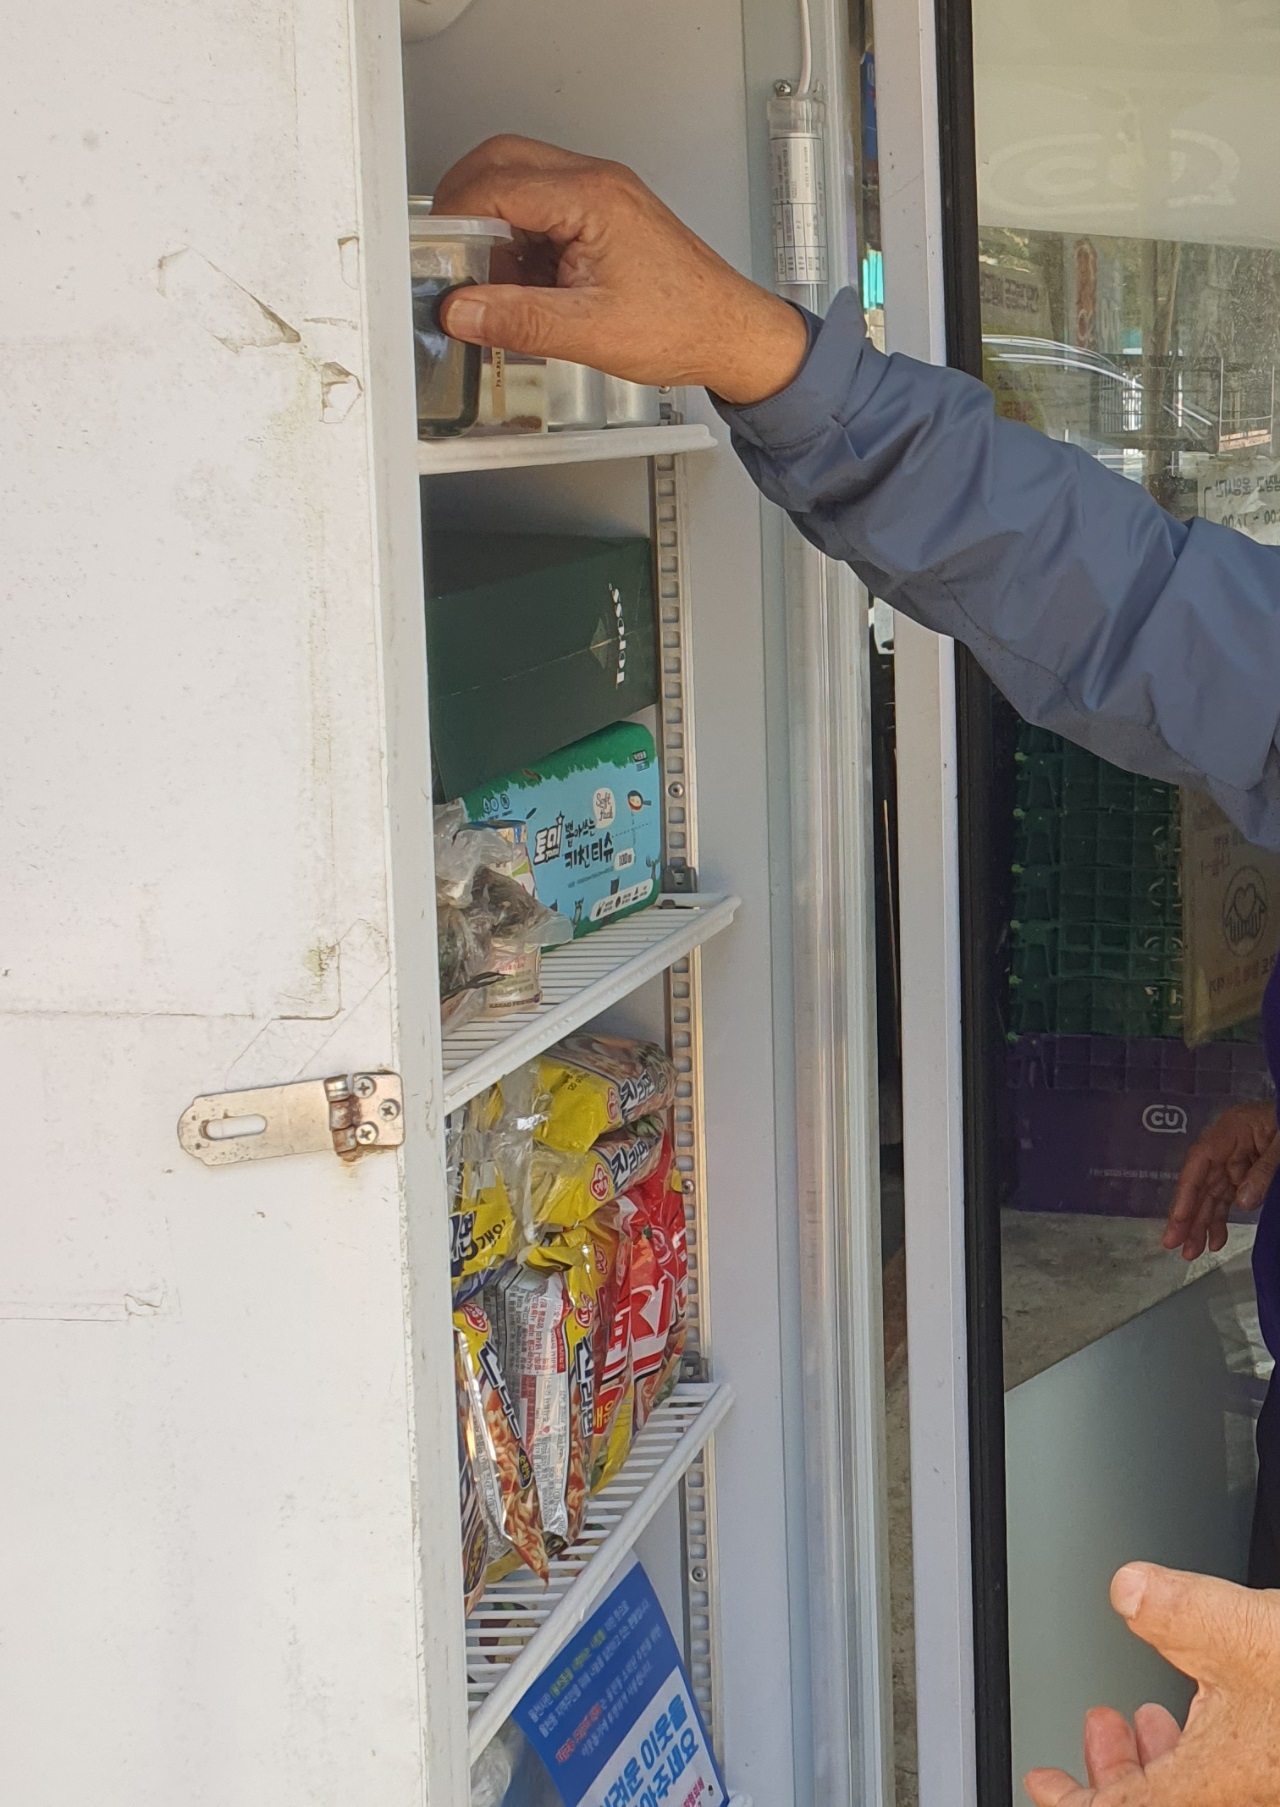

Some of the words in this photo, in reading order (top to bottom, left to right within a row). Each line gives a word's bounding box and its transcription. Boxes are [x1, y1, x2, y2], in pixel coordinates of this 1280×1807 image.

[565, 831, 614, 868] 키친티슈
[619, 1069, 656, 1121] 진라면
[1150, 1111, 1179, 1126] CU
[610, 1138, 649, 1194] 진라면
[641, 1694, 687, 1770] 이웃을
[635, 1727, 699, 1807] 아주세요
